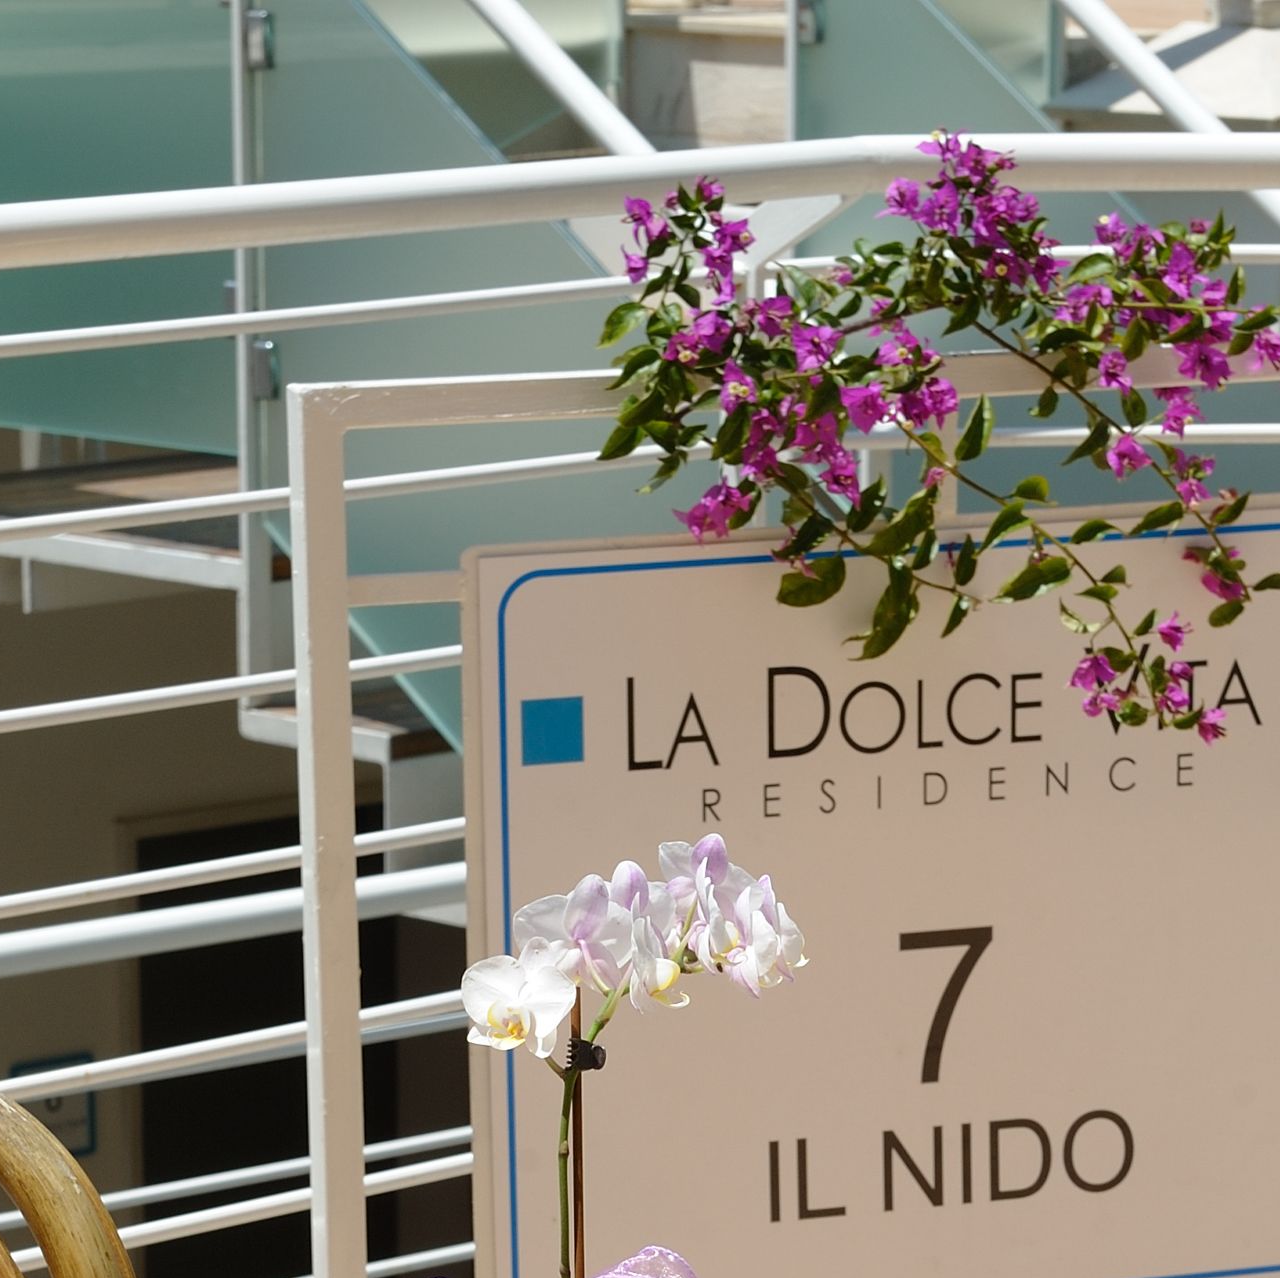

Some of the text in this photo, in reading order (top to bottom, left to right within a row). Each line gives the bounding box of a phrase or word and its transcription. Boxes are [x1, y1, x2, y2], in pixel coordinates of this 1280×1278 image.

[626, 676, 721, 772] LA
[767, 666, 1044, 759] DOLCE
[702, 752, 1194, 823] RESIDENCE
[899, 926, 994, 1084] 7
[768, 1109, 1135, 1223] IL NIDO
